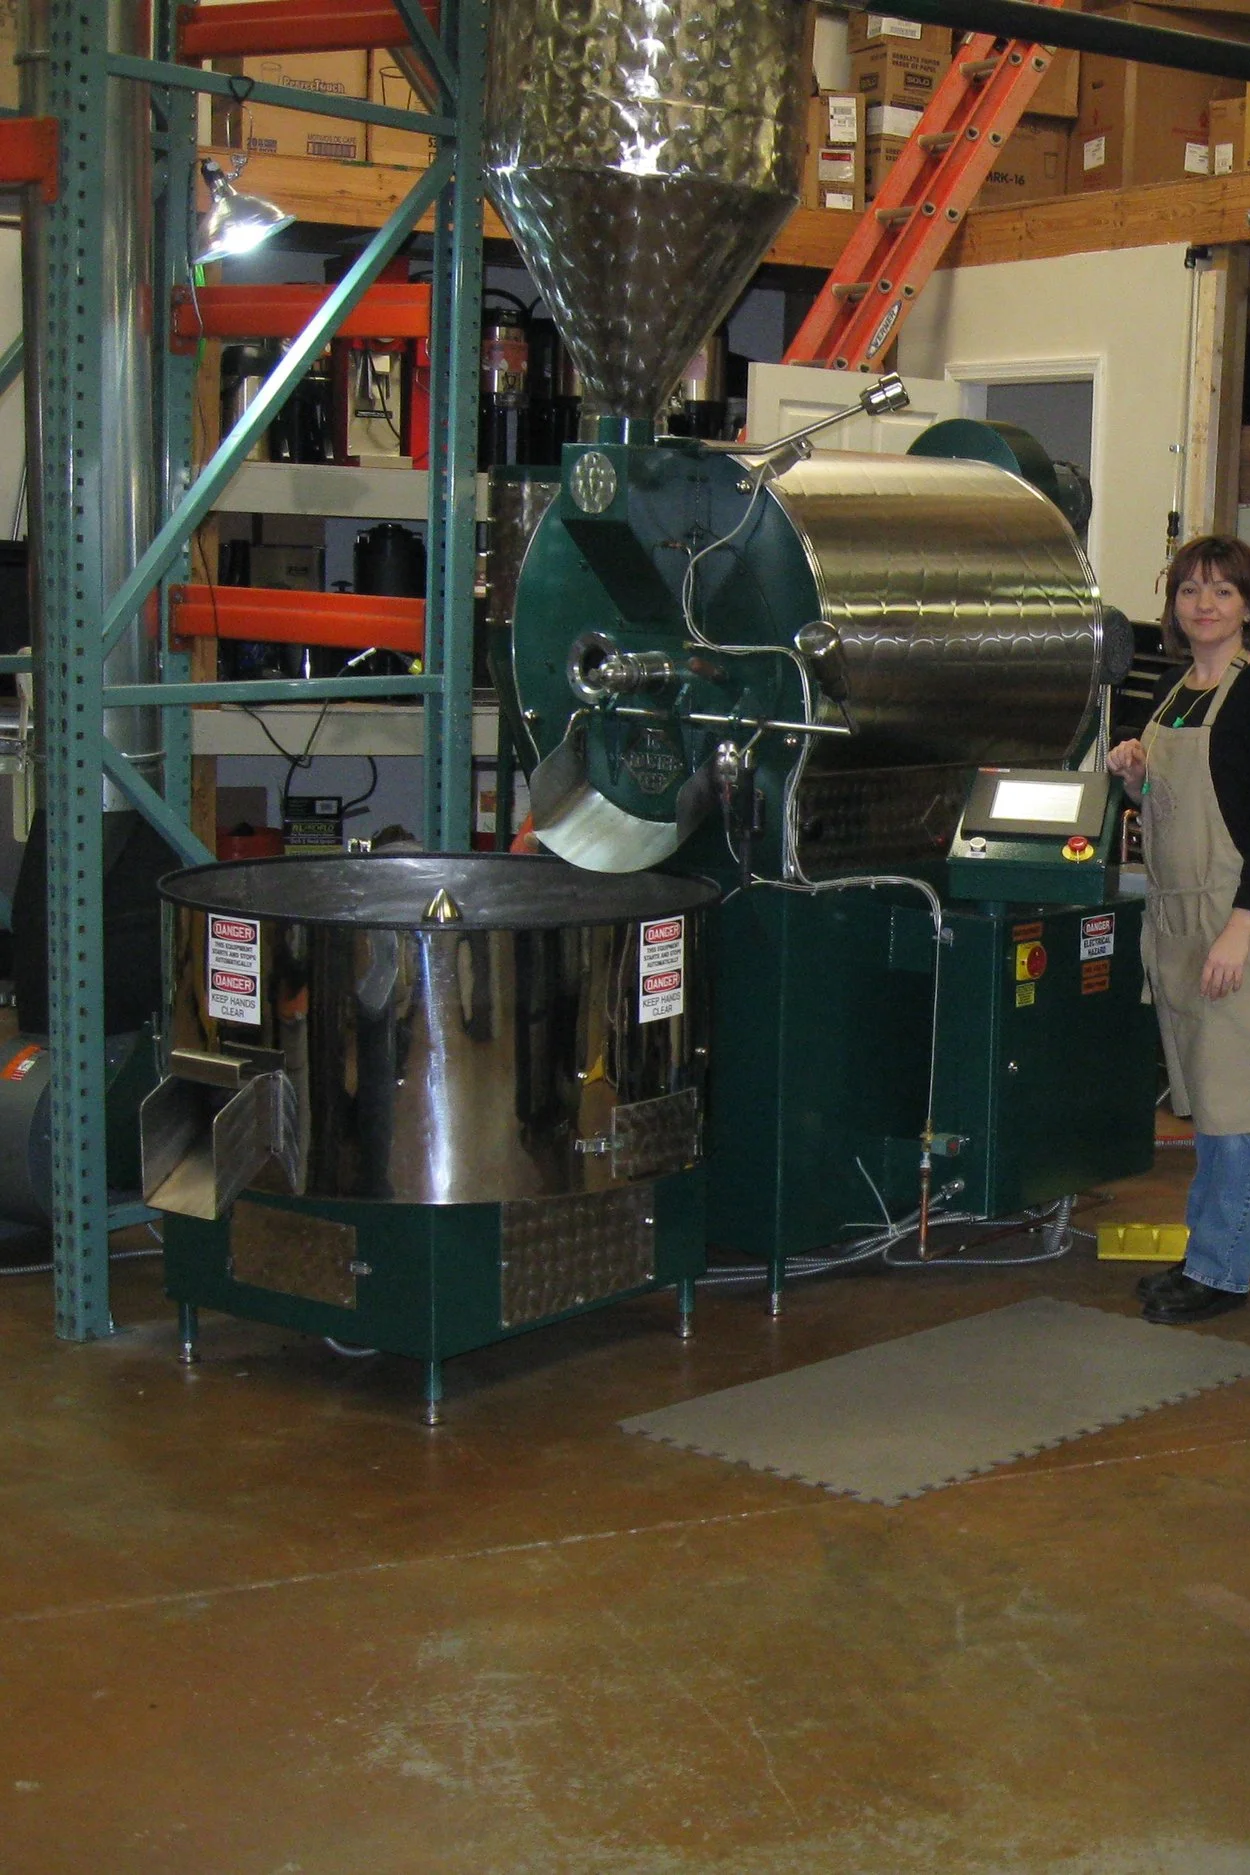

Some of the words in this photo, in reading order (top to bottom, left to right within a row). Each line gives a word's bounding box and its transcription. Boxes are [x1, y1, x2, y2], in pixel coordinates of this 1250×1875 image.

[871, 309, 897, 348] WERNER
[215, 923, 252, 939] DANGER
[648, 925, 679, 940] DANGER
[1086, 920, 1110, 933] DANGER
[1083, 937, 1111, 949] ELECTRICAL
[1088, 946, 1107, 956] HAZARD
[215, 975, 251, 991] DANGER
[646, 976, 678, 991] DANGER
[211, 993, 229, 1004] KEEP
[230, 996, 256, 1009] HANDS
[642, 997, 660, 1008] KEEP
[661, 992, 681, 1003] HANDS
[221, 1006, 245, 1018] CLEAR
[653, 1005, 672, 1016] CLEAR
